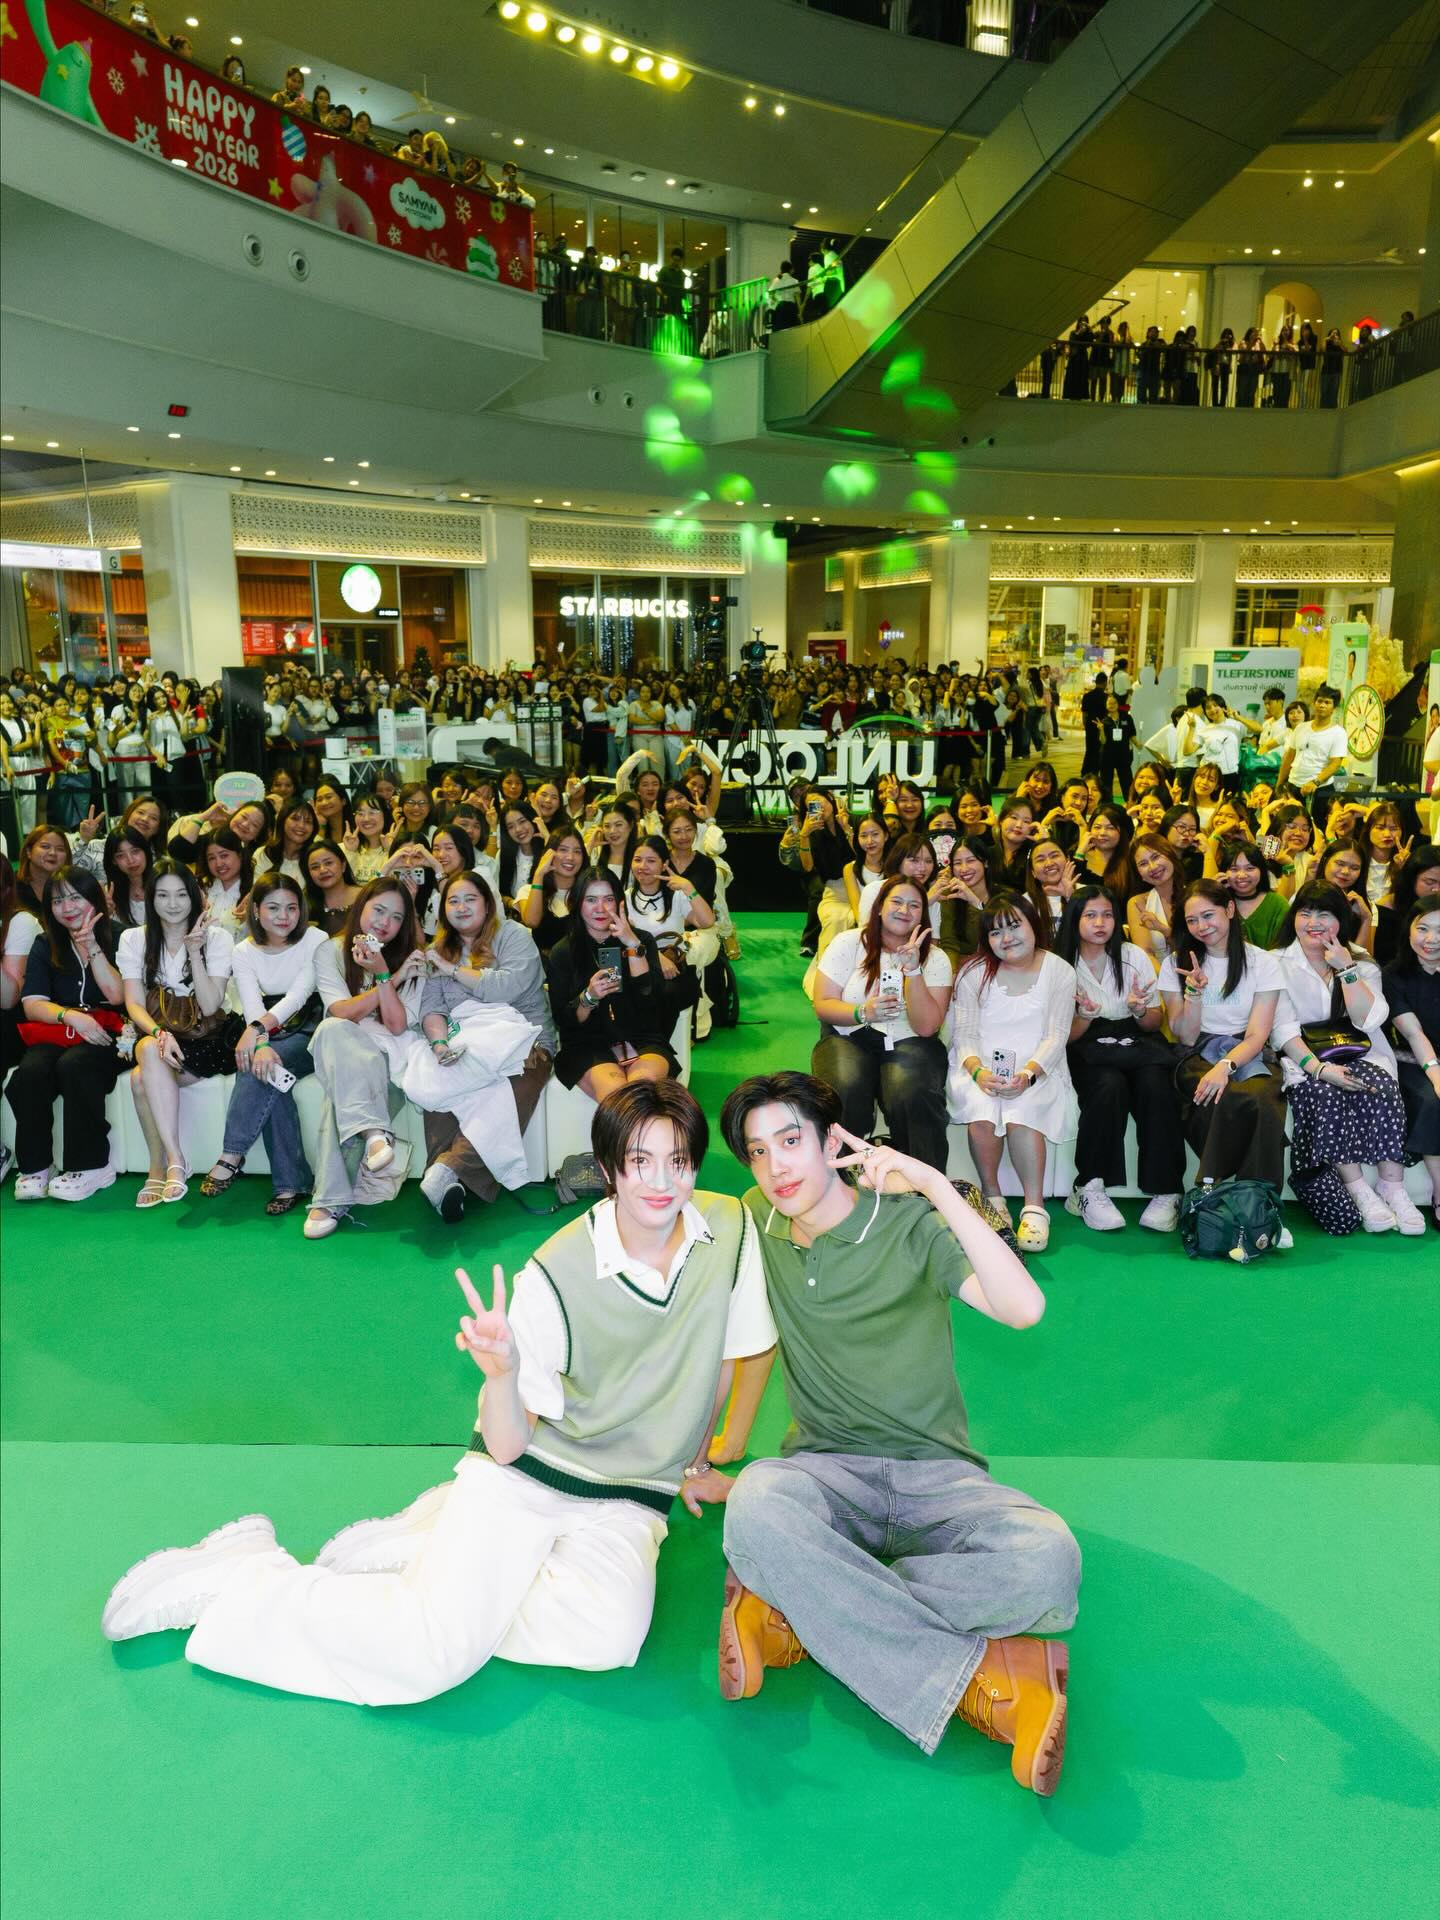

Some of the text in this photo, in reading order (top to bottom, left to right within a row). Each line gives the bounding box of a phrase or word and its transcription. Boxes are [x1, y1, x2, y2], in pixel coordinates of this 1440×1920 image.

[164, 63, 255, 139] HAPPY
[166, 106, 260, 170] NEW YEAR
[193, 147, 239, 185] 2026
[398, 191, 437, 215] SAMYAN
[109, 556, 118, 569] G
[560, 596, 689, 618] STARBUCKS
[1216, 668, 1296, 679] TLEFIRSTONE
